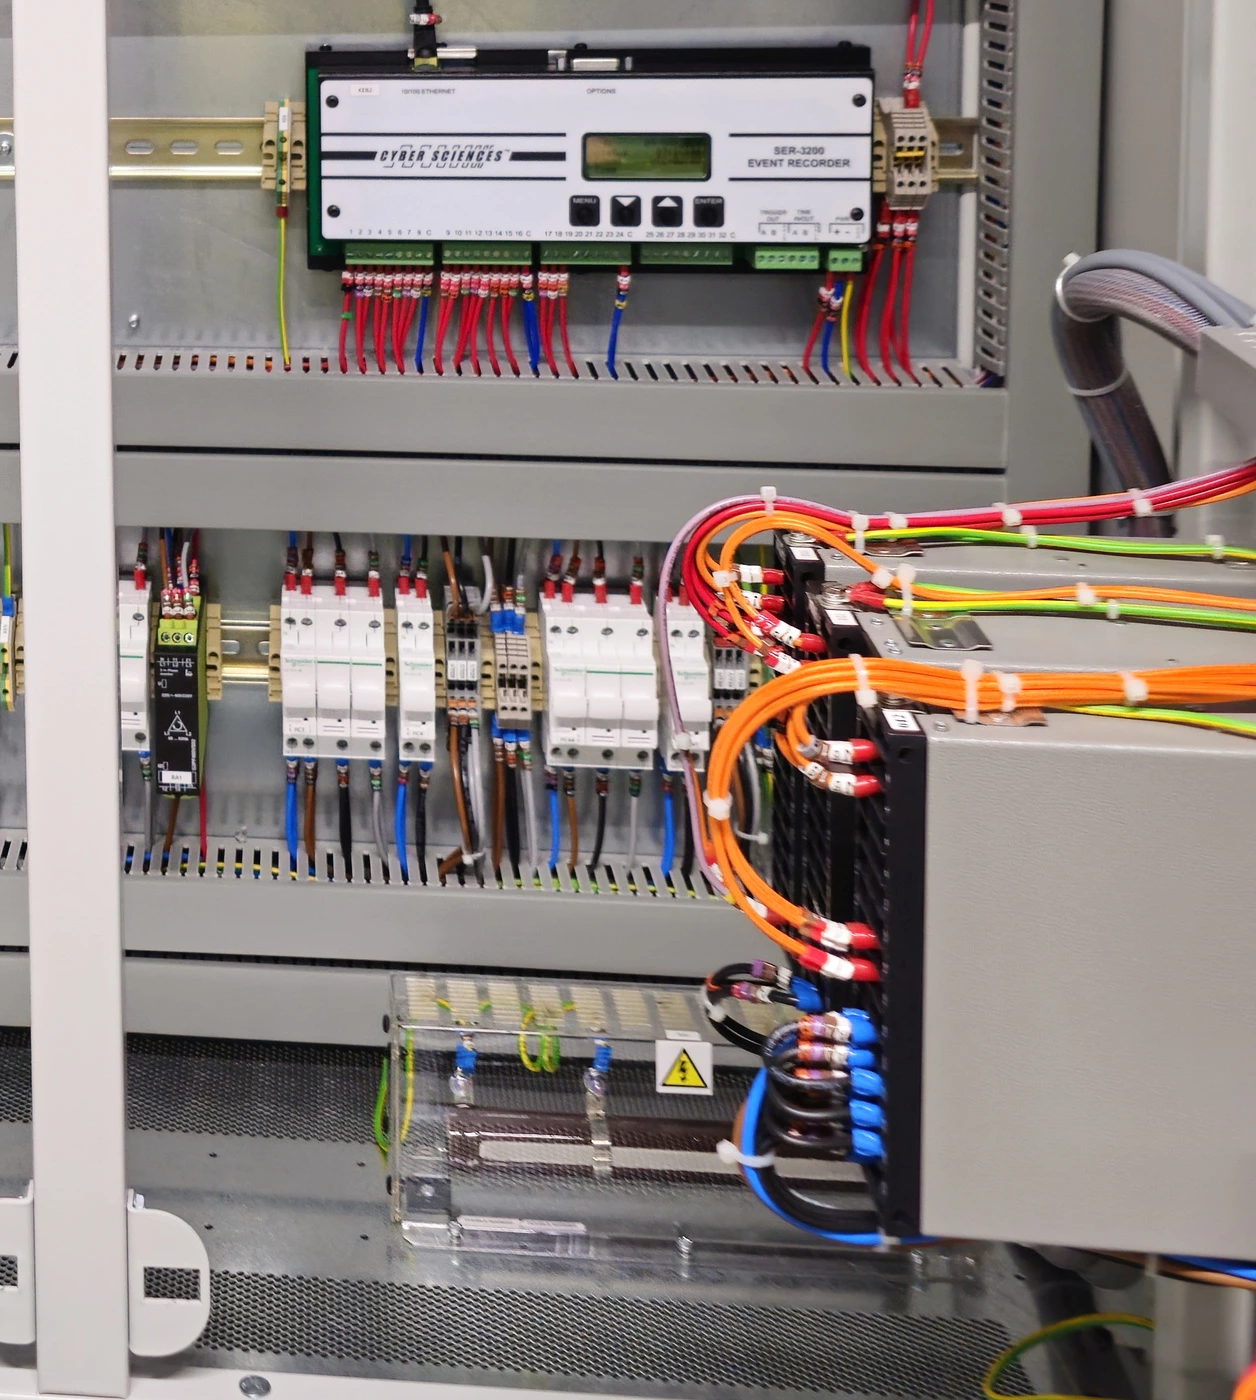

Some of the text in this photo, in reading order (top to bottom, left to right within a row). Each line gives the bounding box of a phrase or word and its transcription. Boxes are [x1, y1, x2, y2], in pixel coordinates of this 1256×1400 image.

[774, 147, 825, 155] SER-3200
[380, 150, 503, 162] CYBER SCIENCES
[748, 159, 850, 168] EVENT RECORDER
